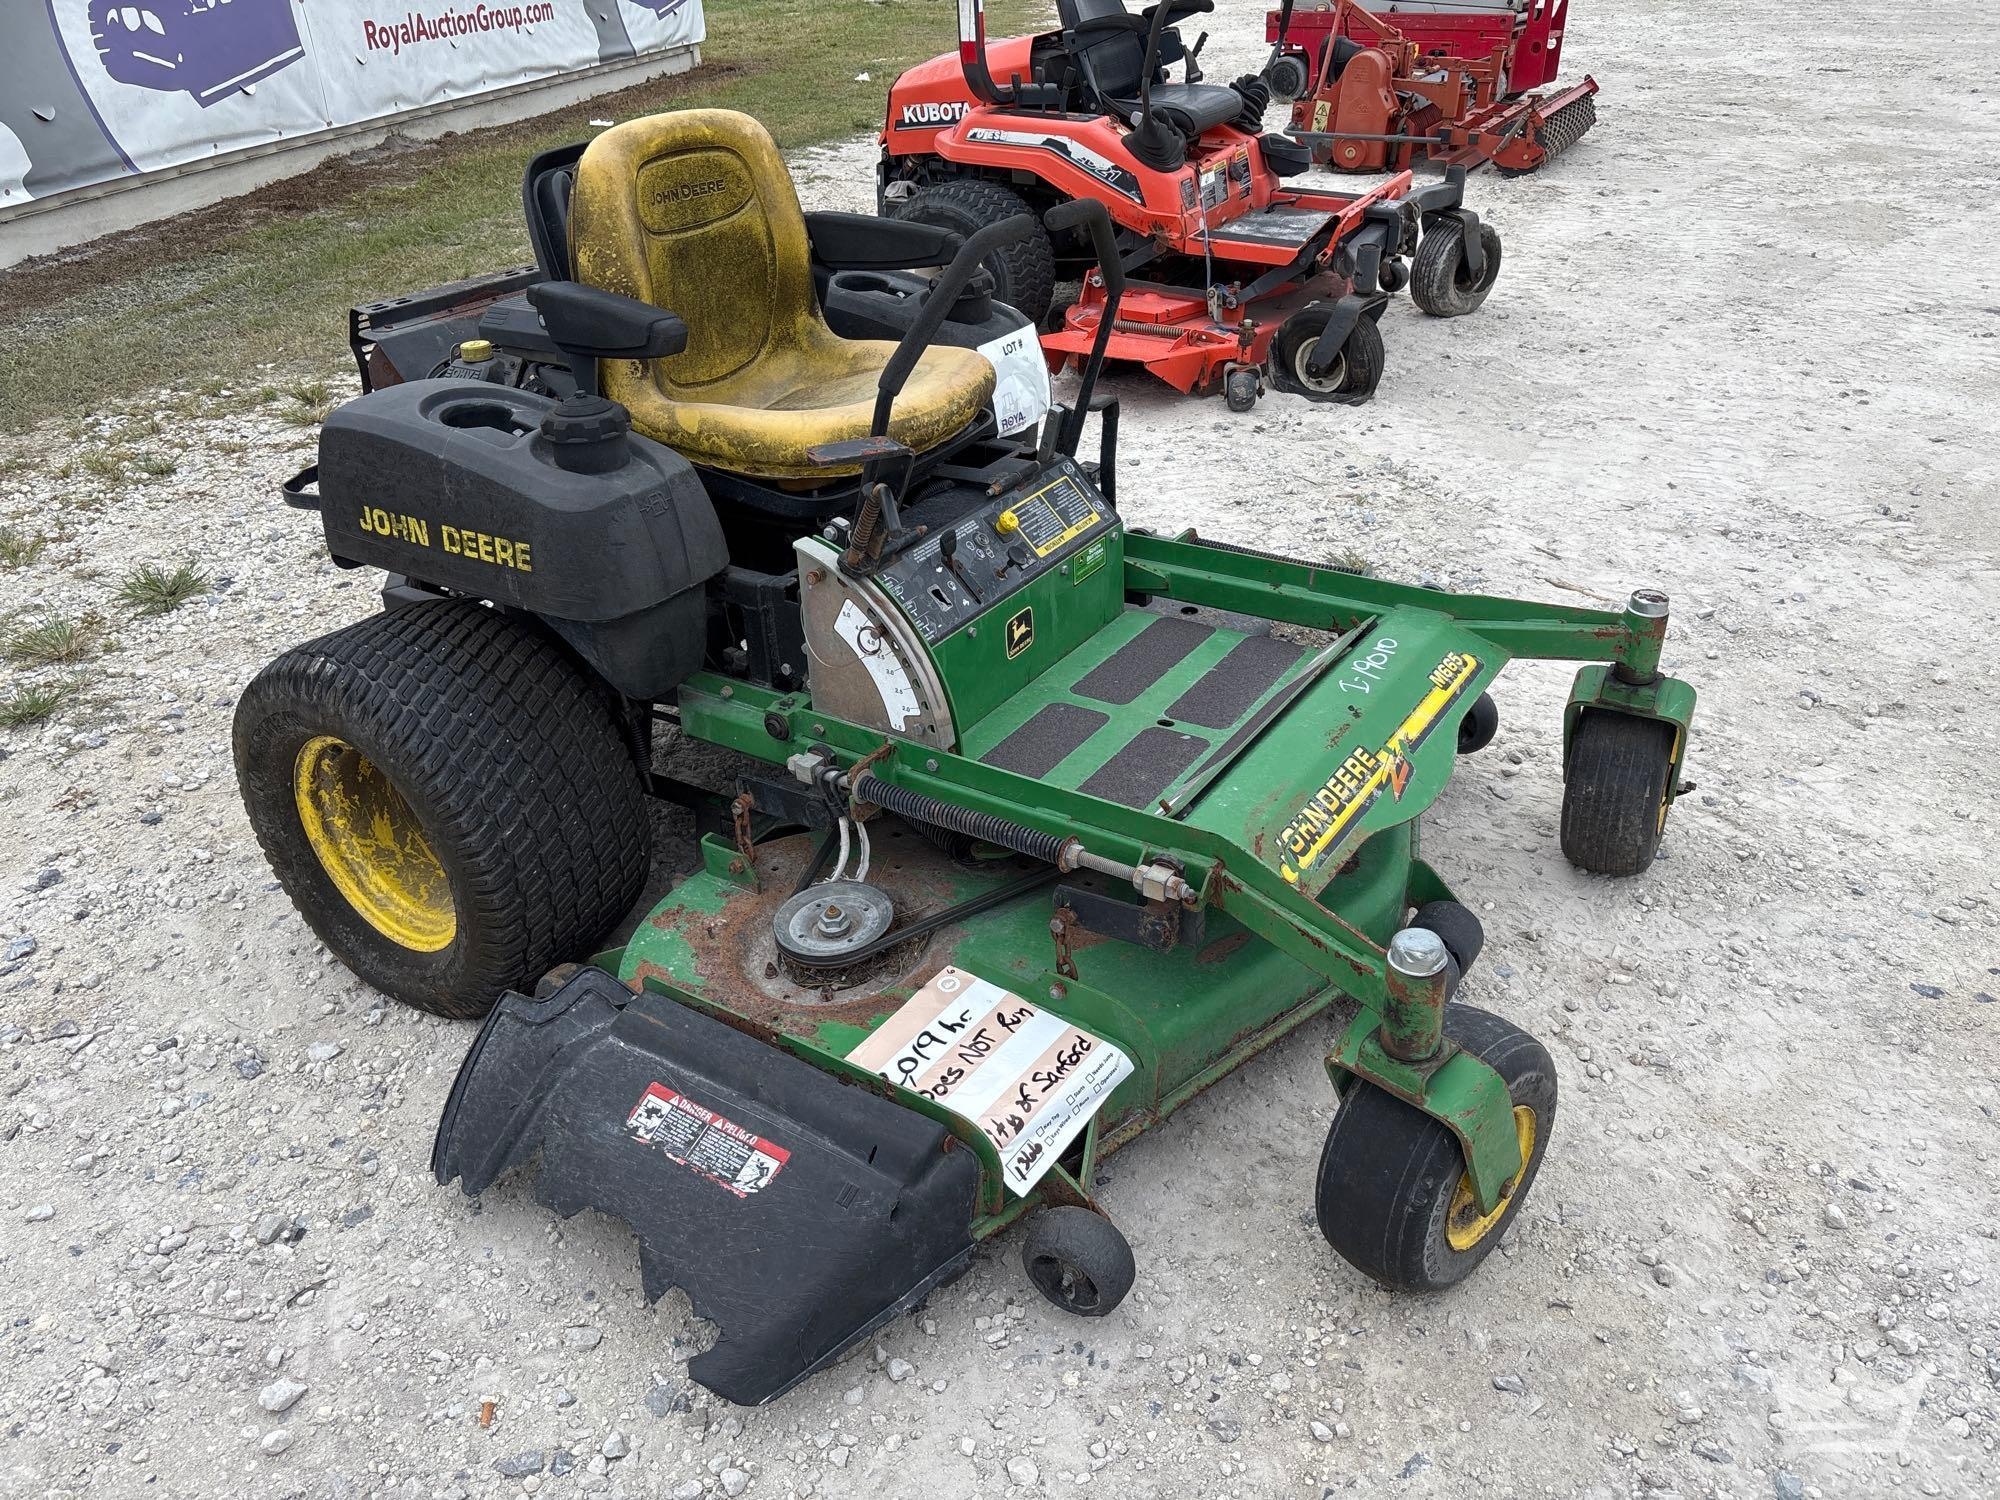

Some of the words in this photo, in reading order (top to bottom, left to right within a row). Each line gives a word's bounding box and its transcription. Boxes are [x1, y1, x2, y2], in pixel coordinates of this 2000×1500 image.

[363, 2, 555, 55] RoyalAuctionGroup.com
[902, 103, 971, 123] KUBOTA
[651, 189, 680, 206] JOHN
[680, 180, 726, 199] DEERE
[1002, 341, 1017, 356] LOT
[1001, 411, 1026, 430] ROYA
[359, 505, 430, 547] JOHN
[441, 524, 532, 573] DEERE
[1428, 651, 1464, 689] M665
[1275, 800, 1329, 861] OHN
[1315, 747, 1377, 812] DEERE
[958, 1028, 996, 1065] NOT
[679, 1099, 713, 1122] DANGER
[984, 1113, 1025, 1150] ity
[1016, 1082, 1038, 1114] of
[1032, 1035, 1092, 1093] Sanford
